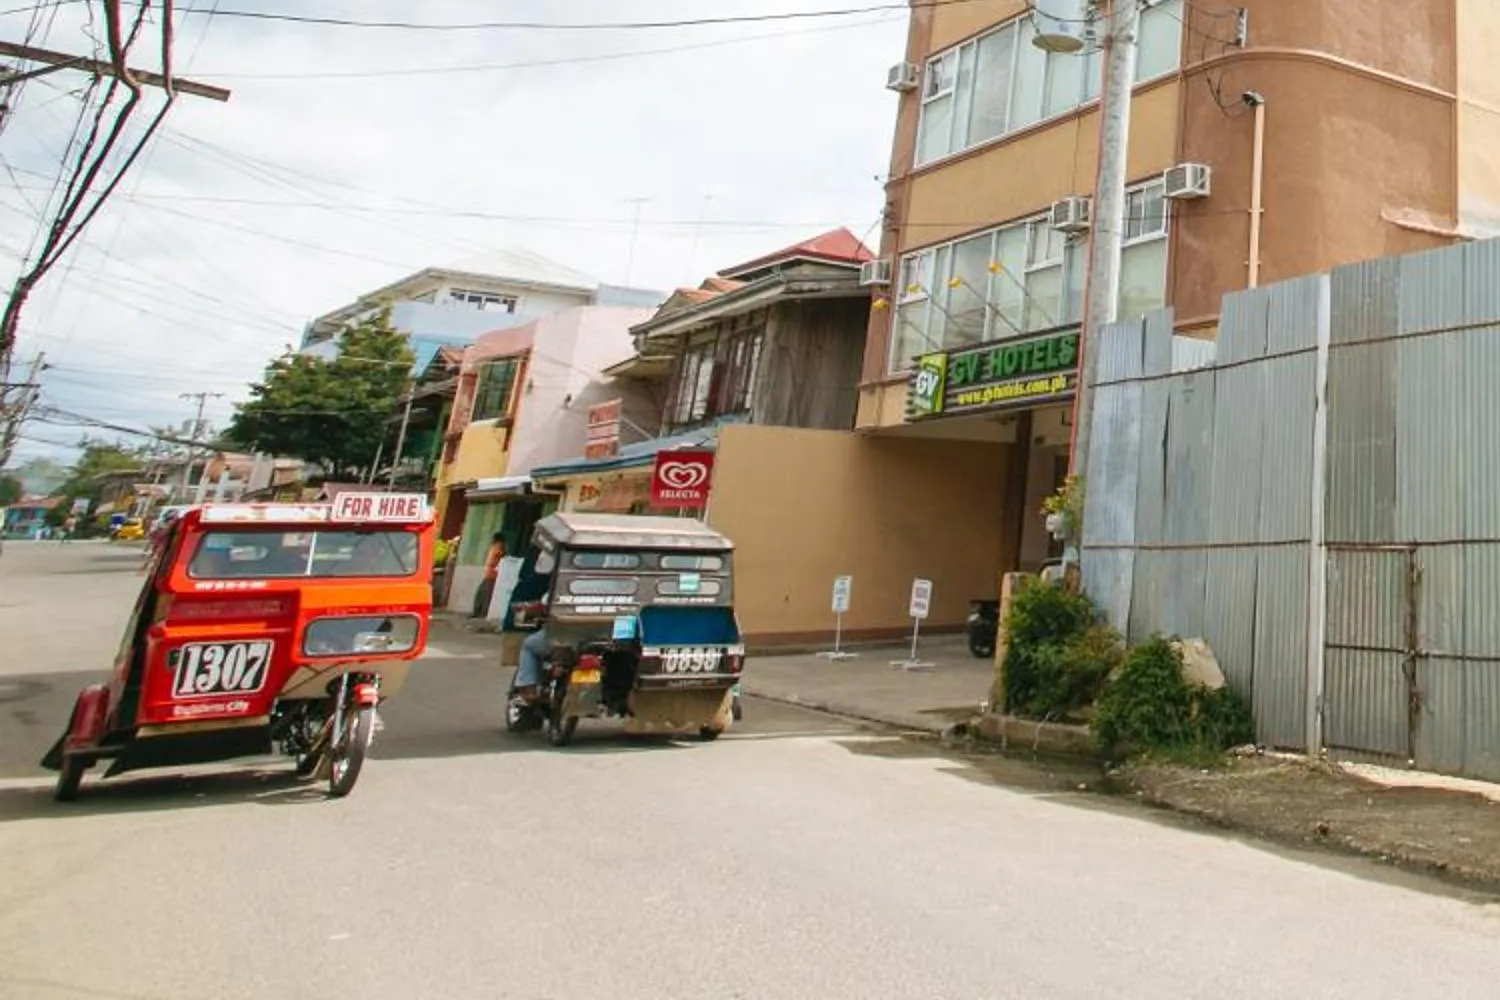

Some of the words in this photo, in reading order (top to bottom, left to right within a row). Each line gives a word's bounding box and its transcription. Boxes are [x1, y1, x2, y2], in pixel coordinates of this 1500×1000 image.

[952, 353, 980, 385] GV
[989, 335, 1077, 377] HOTELS
[916, 371, 940, 396] GV
[341, 496, 373, 517] FOR
[377, 496, 419, 517] HIRE
[660, 489, 700, 500] SELECTA
[178, 643, 268, 693] 1307
